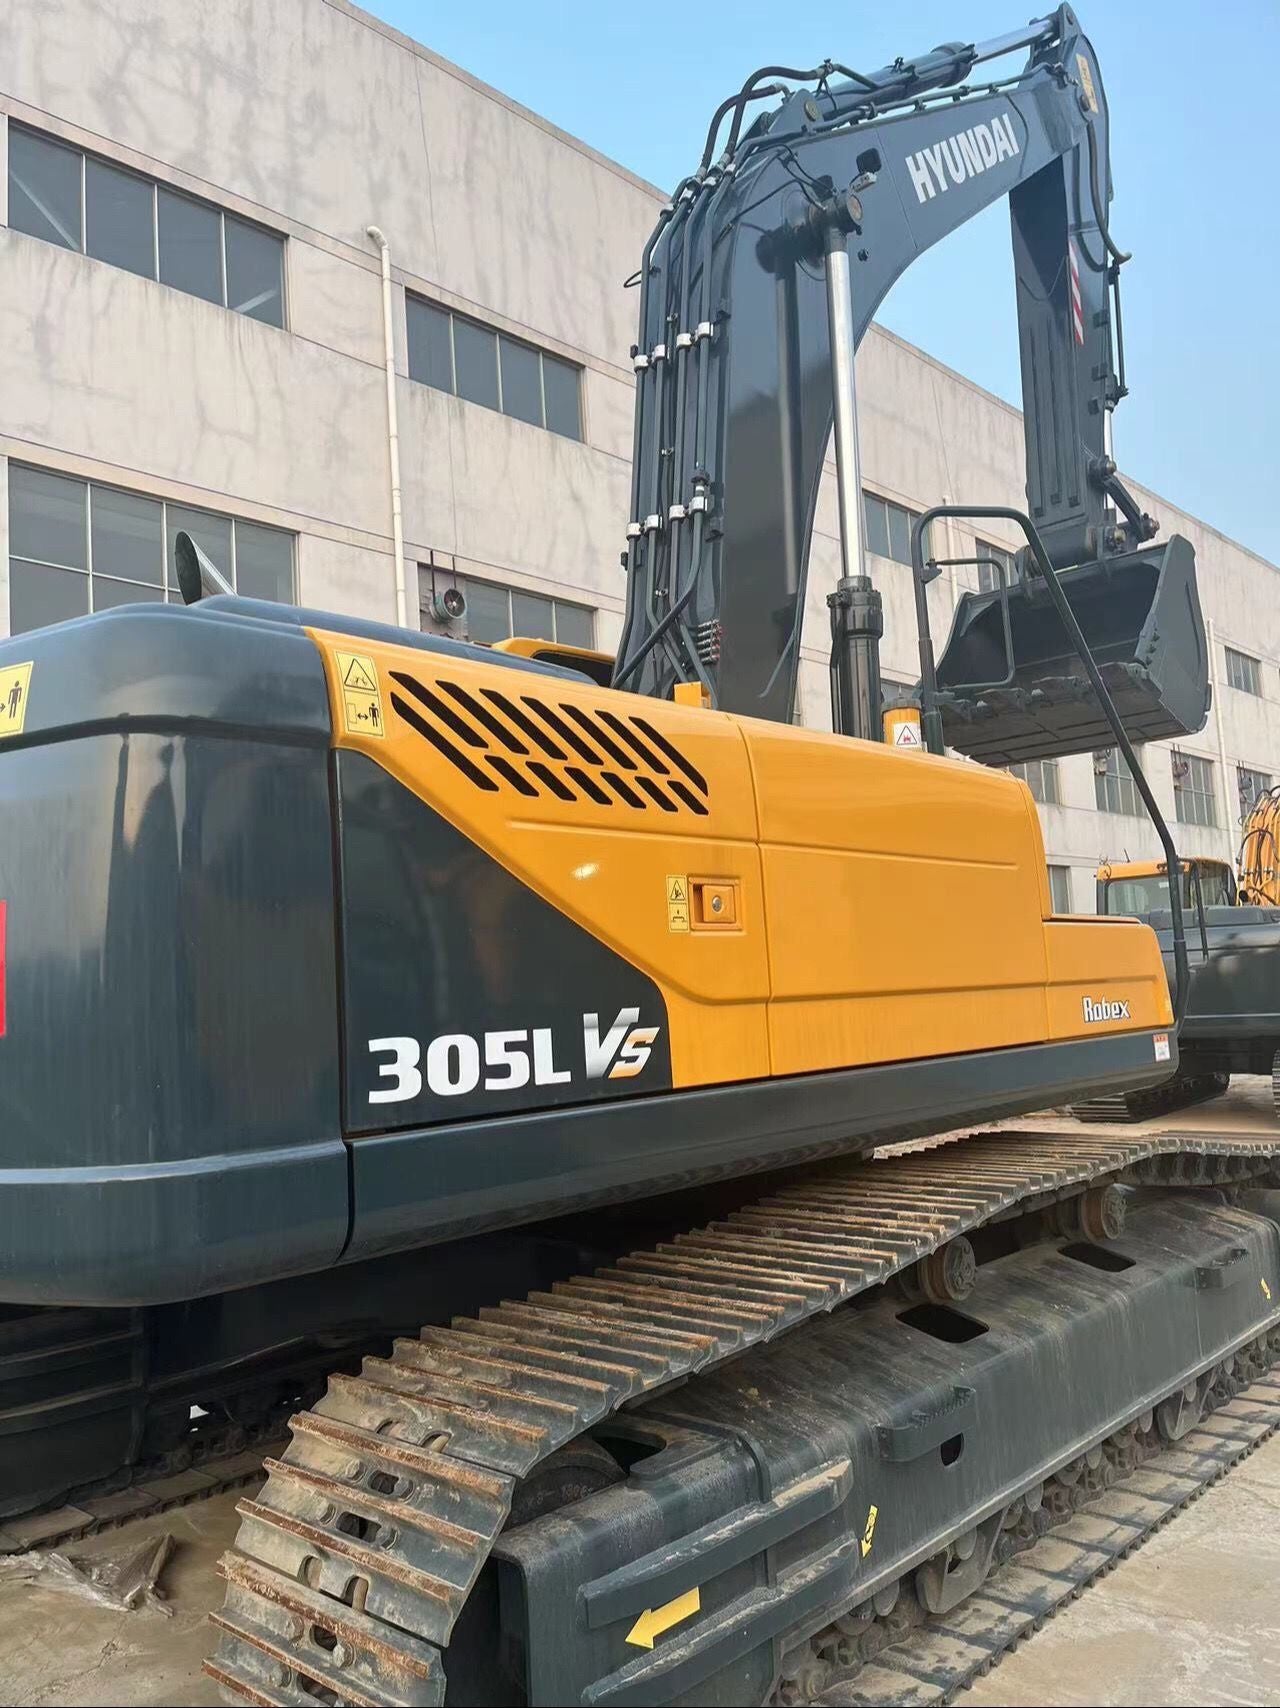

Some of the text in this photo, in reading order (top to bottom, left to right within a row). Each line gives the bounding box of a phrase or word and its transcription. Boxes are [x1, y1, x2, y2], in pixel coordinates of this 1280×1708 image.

[905, 113, 1020, 204] HYUNDAI
[1083, 996, 1130, 1022] Robex
[368, 1028, 571, 1103] 305L
